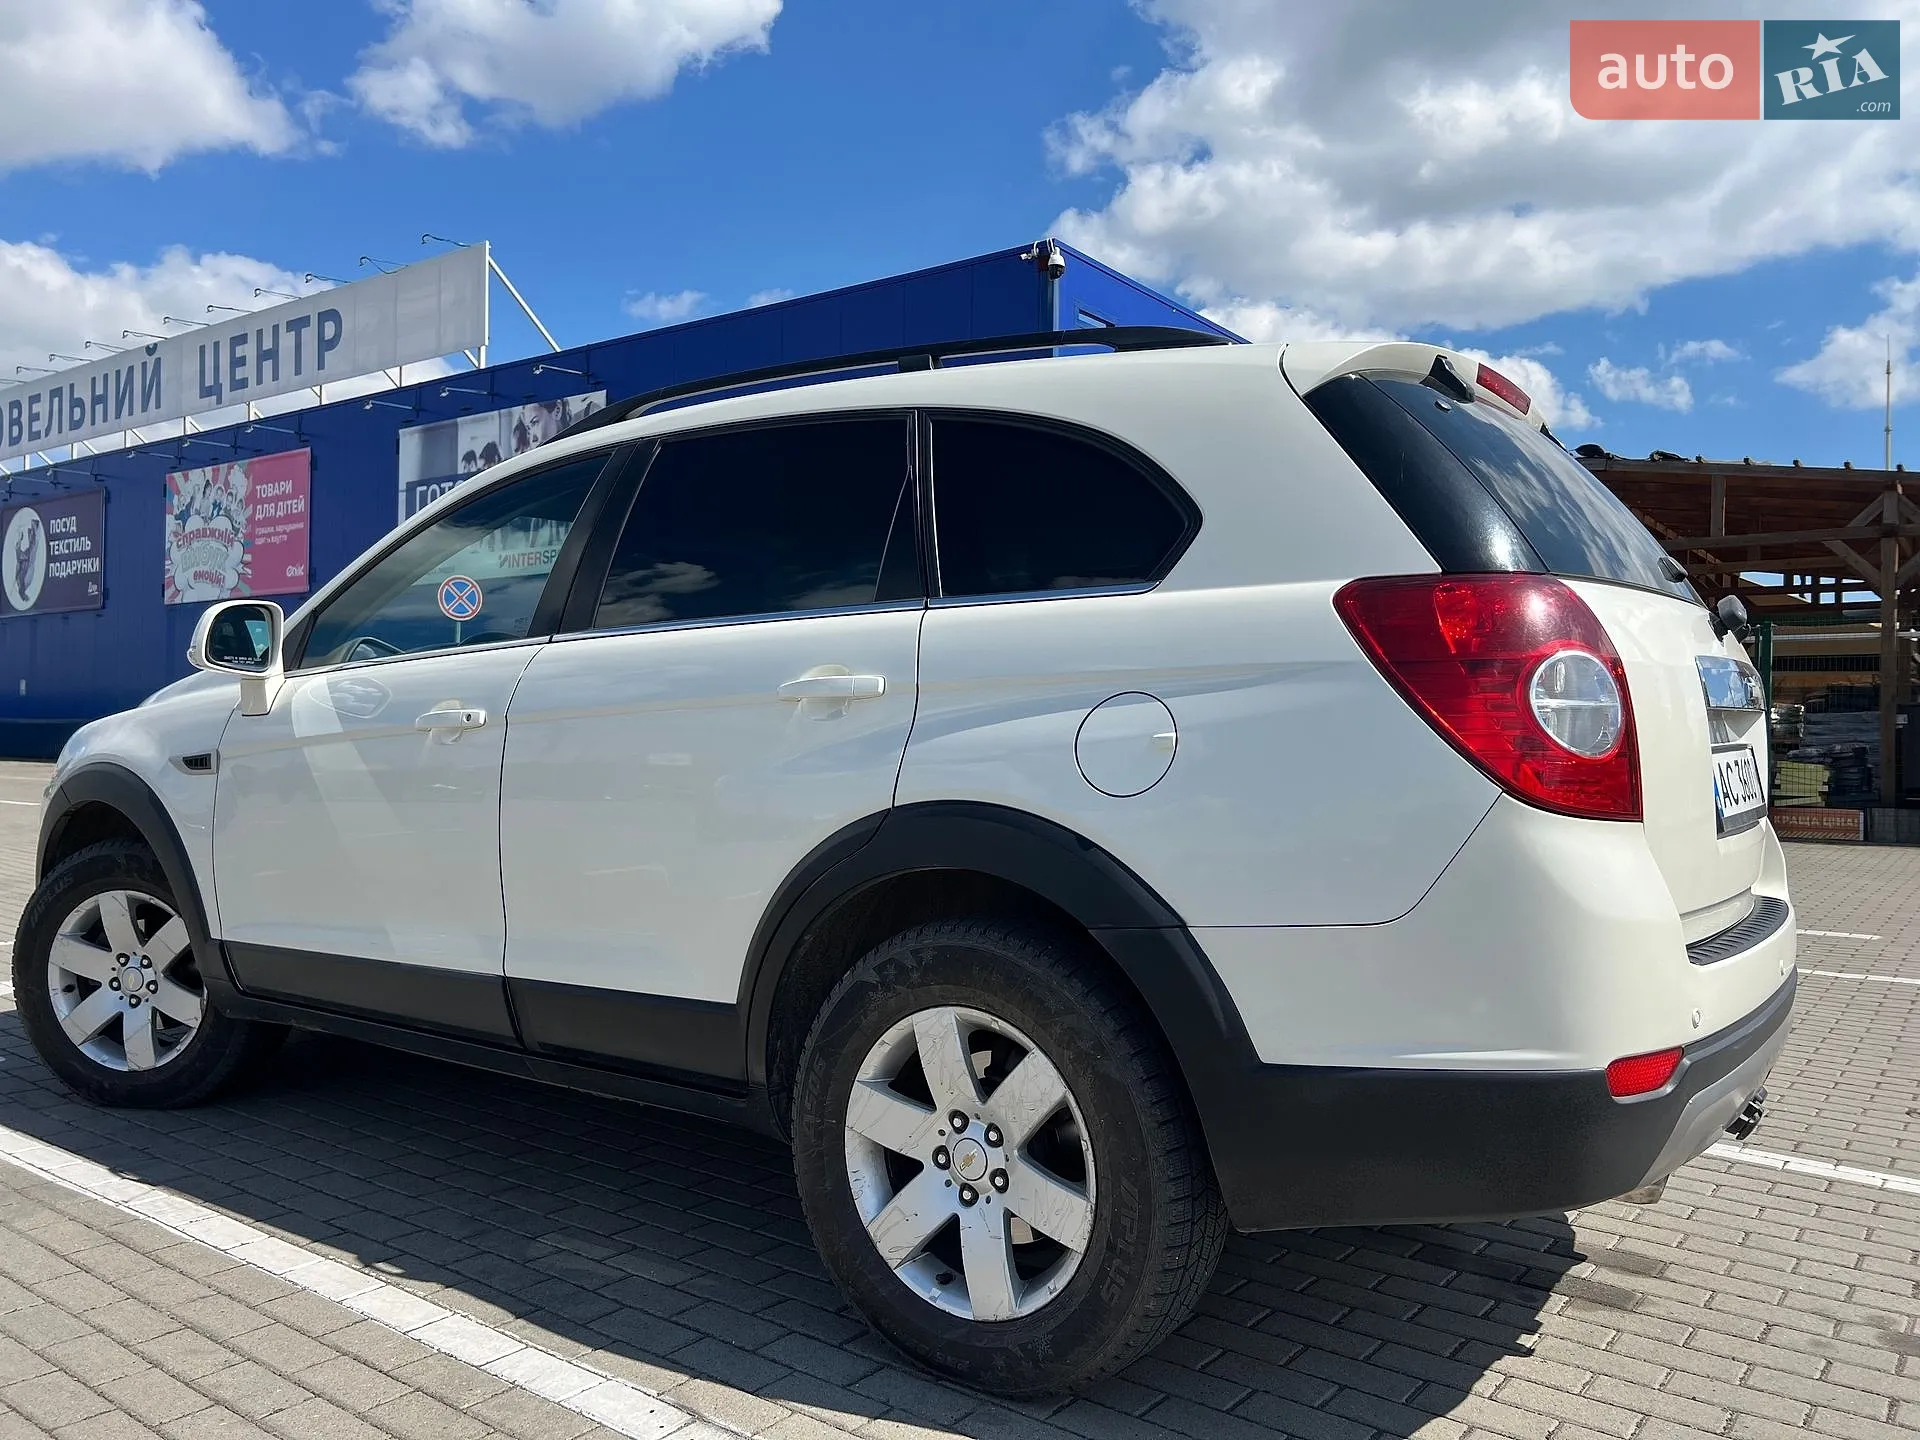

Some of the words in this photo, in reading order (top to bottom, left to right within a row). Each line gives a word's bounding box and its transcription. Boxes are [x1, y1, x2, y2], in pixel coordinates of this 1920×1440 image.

[0, 342, 162, 447] ВЕЛЬНИЙ
[199, 308, 343, 406] ЦЕНТР
[256, 479, 293, 498] ТОВАРИ
[255, 502, 276, 521] ДЛЯ
[276, 494, 305, 518] ДІТЕЙ
[50, 516, 77, 534] ПОСУД
[49, 536, 92, 556] ТЕКСТИЛЬ
[49, 557, 100, 578] ПОДАРУНКИ
